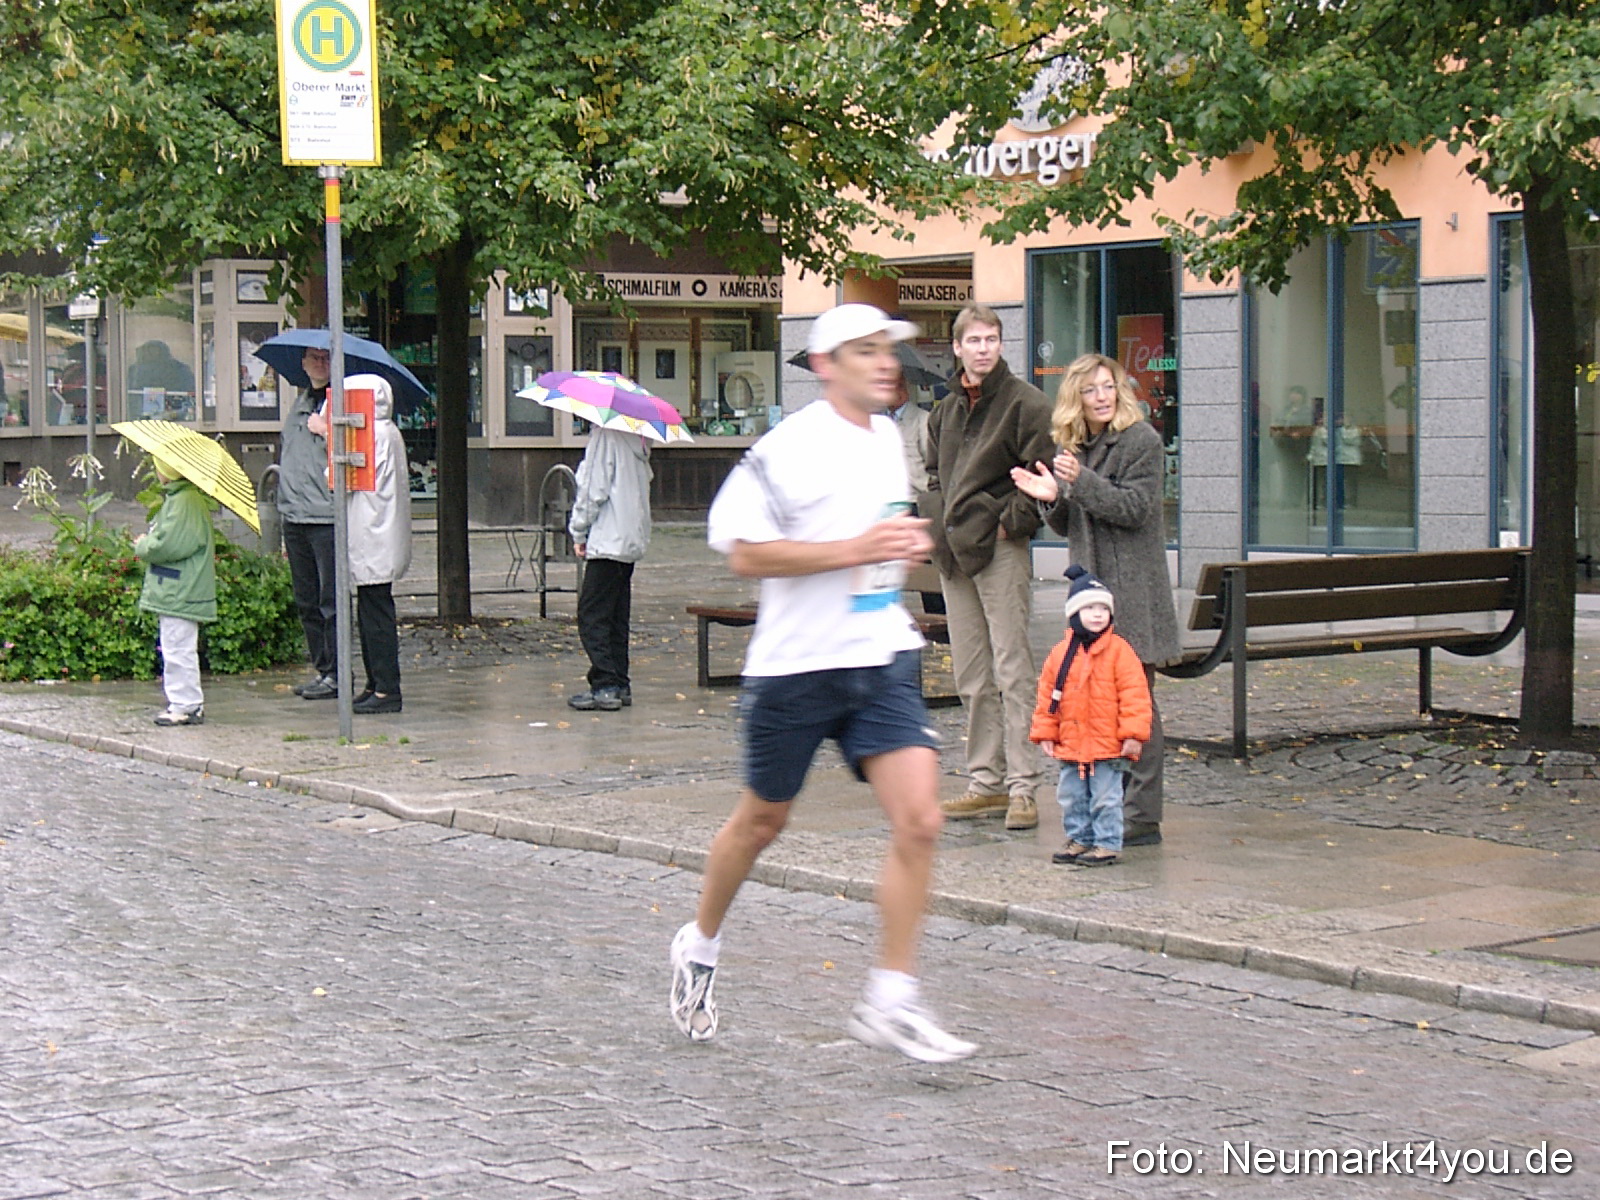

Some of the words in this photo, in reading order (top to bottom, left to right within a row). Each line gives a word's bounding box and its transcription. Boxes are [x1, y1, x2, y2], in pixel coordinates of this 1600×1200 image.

[311, 15, 344, 55] H
[292, 81, 330, 92] Oberer
[335, 82, 366, 92] Markt
[607, 279, 681, 297] SCHMALFILM
[1147, 358, 1177, 371] ALESSI
